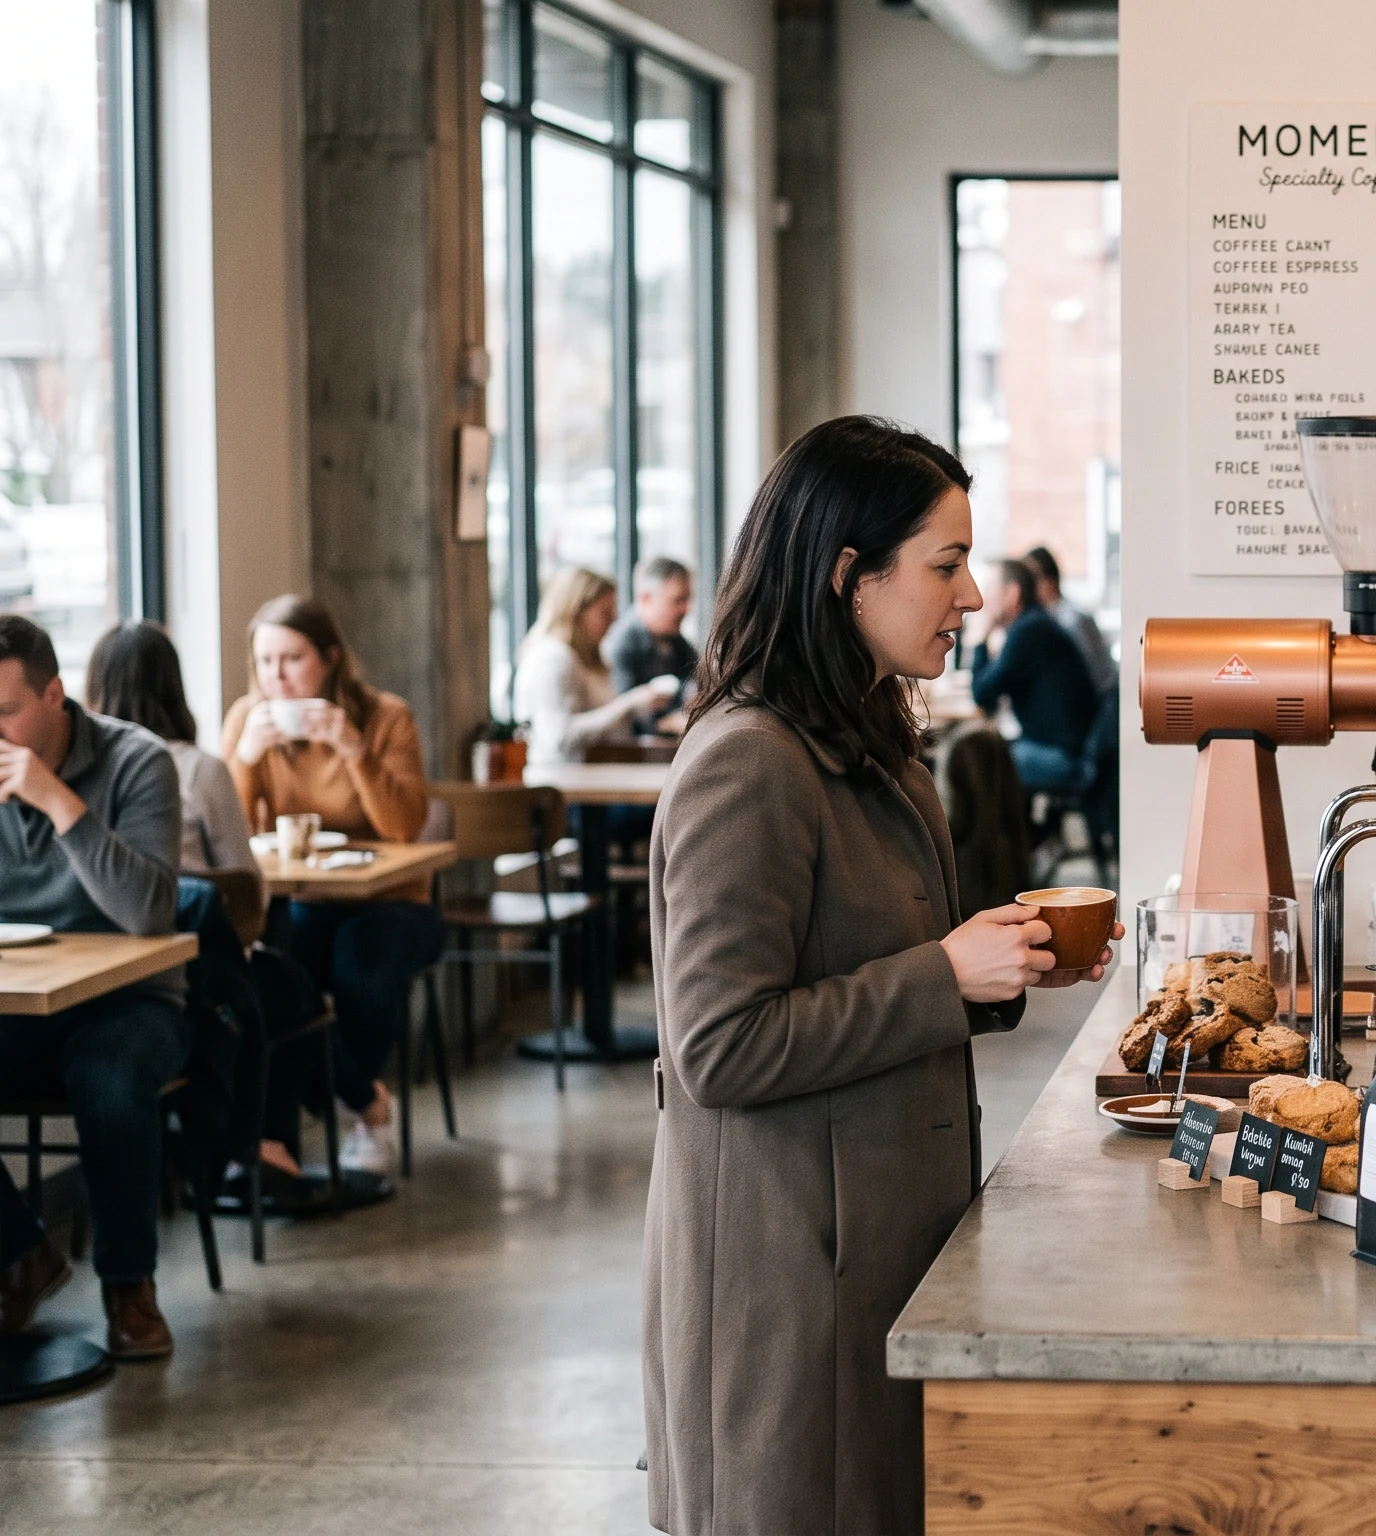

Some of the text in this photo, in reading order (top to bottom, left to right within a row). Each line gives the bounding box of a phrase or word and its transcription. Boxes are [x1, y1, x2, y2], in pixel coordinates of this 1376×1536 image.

[1259, 166, 1345, 195] Specialty
[1212, 213, 1267, 230] MENU
[1280, 282, 1309, 294] PEO
[1269, 323, 1296, 335] TEA
[1213, 368, 1286, 384] BAKEDS
[1215, 461, 1260, 475] FRICE
[1214, 500, 1286, 516] FOREES
